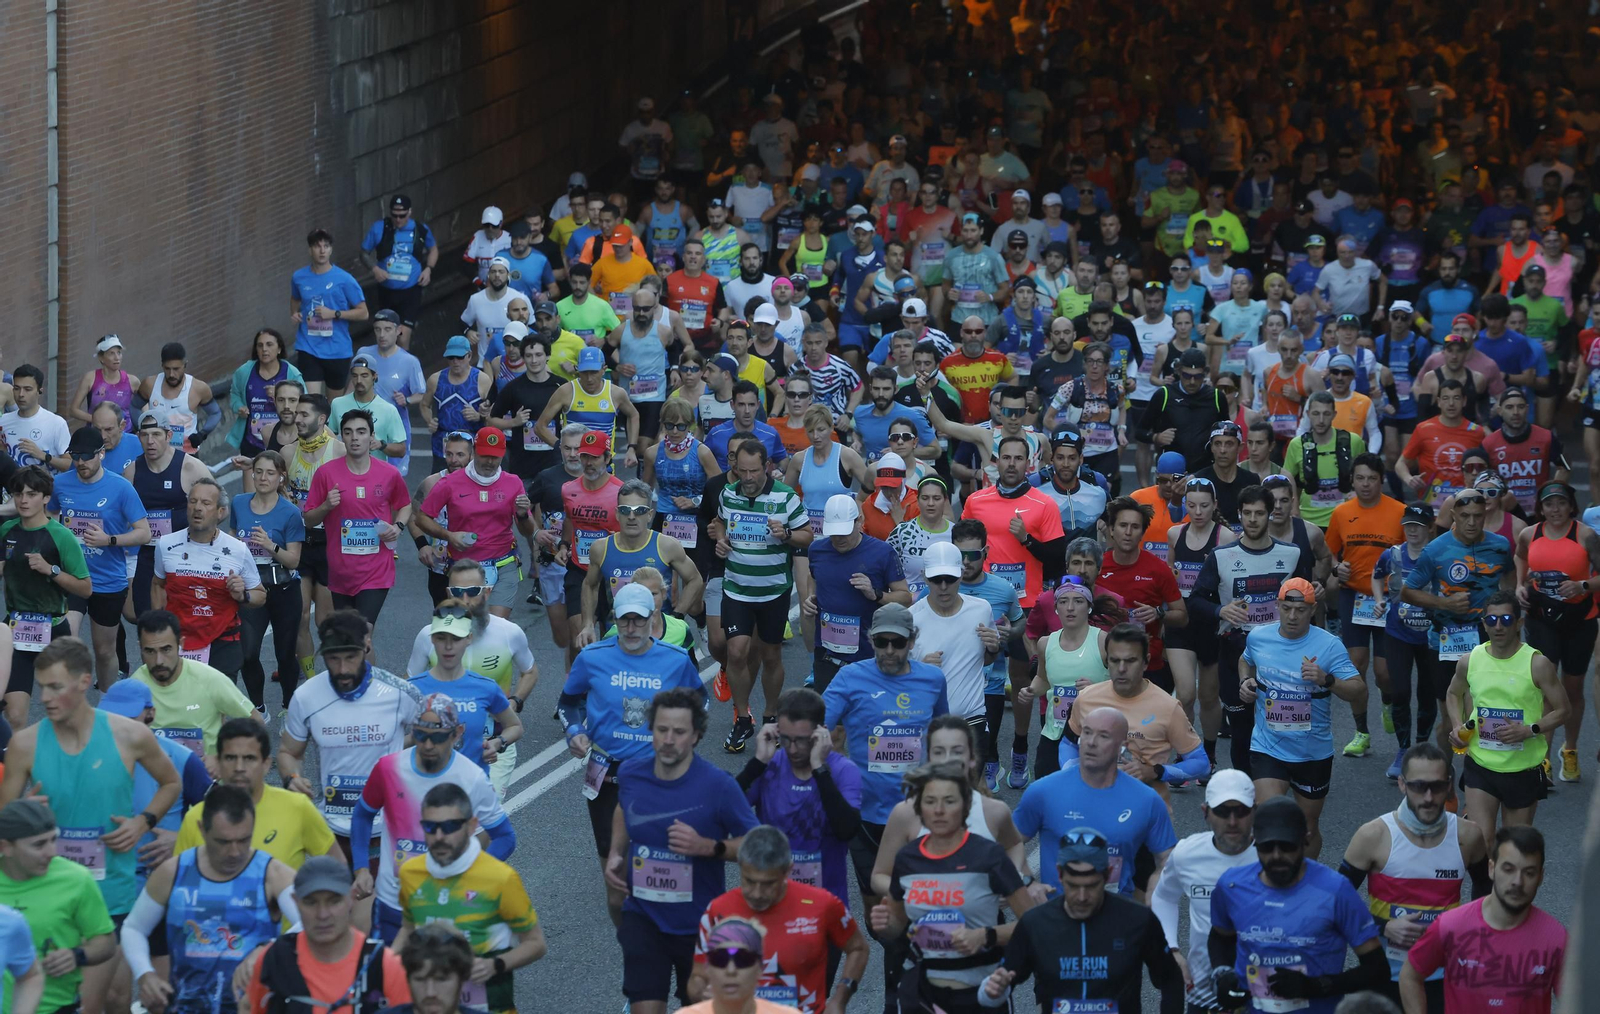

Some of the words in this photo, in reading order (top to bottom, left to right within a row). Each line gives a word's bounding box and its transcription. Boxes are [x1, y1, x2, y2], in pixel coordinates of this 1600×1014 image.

[1498, 459, 1542, 478] BAXI
[571, 508, 609, 519] ULTRA
[346, 538, 376, 547] DUARTE
[728, 533, 747, 541] NUNO
[748, 534, 767, 542] PITTA
[1000, 564, 1021, 572] ZURIC
[1254, 594, 1277, 603] ZURICH
[23, 614, 48, 622] ZURICH
[831, 616, 856, 624] ZURICH
[1247, 611, 1274, 622] VÍCTOR
[1450, 625, 1473, 633] ZURICH
[14, 632, 43, 643] STRIKE
[610, 670, 662, 691] sljeme
[1280, 692, 1306, 700] ZURICH
[1280, 704, 1295, 712] 9406
[1265, 712, 1283, 721] JAVI
[1291, 712, 1311, 722] SILO
[168, 730, 197, 738] ZURICH
[322, 724, 380, 736] RECURRENT
[886, 727, 916, 735] ZURICH
[346, 733, 387, 744] ENERGY
[612, 731, 633, 741] ULTRA
[887, 741, 904, 749] 8910
[875, 750, 914, 761] ANDRÉS
[343, 778, 367, 786] ZURIC
[63, 829, 99, 838] ZURICH
[652, 850, 686, 862] ZURICH
[646, 875, 677, 889] OLMO
[906, 889, 965, 907] PARIS
[925, 912, 958, 922] ZURICH
[1250, 926, 1284, 936] CLUB
[1059, 956, 1080, 970] WE
[1081, 956, 1108, 970] RUN
[1262, 956, 1300, 965] ZURICH
[1059, 969, 1108, 980] BARCELONA
[1073, 1001, 1110, 1012] ZURICH
